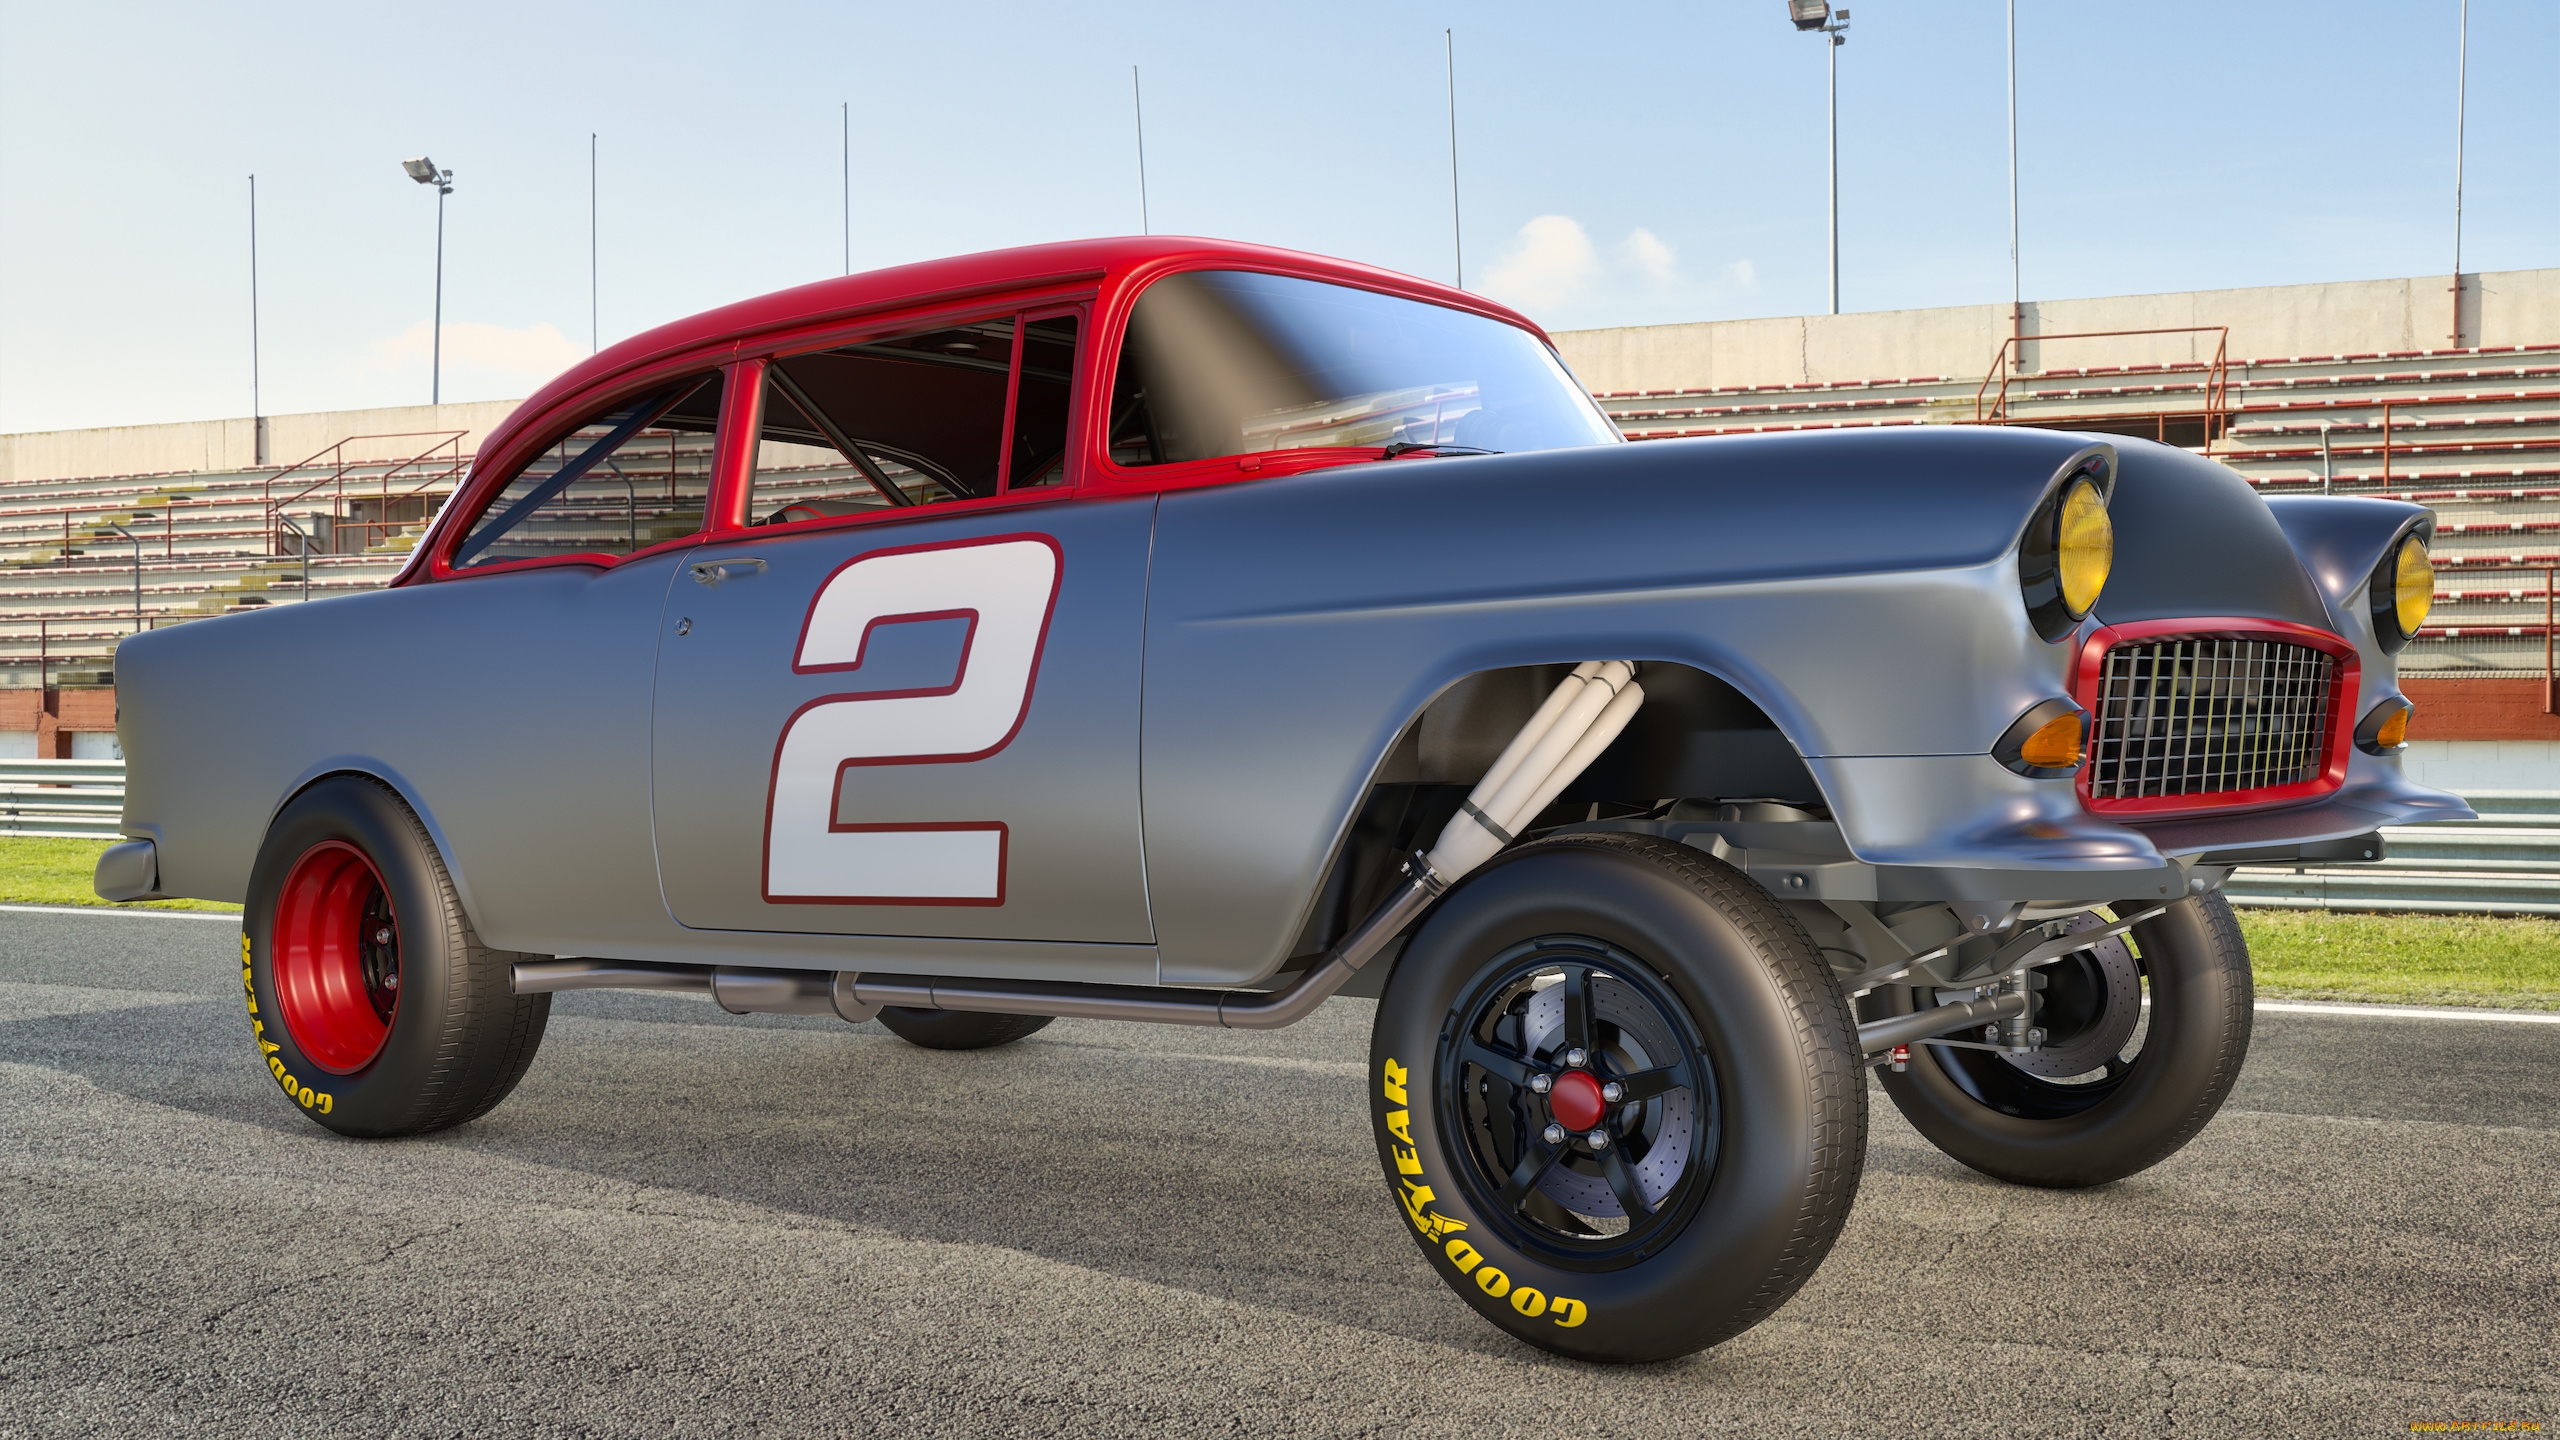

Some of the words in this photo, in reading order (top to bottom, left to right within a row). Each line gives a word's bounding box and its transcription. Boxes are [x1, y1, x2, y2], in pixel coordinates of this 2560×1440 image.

[762, 532, 1064, 906] 2
[242, 932, 333, 1114] GOODYEAR
[1384, 1057, 1588, 1328] GOODYEAR
